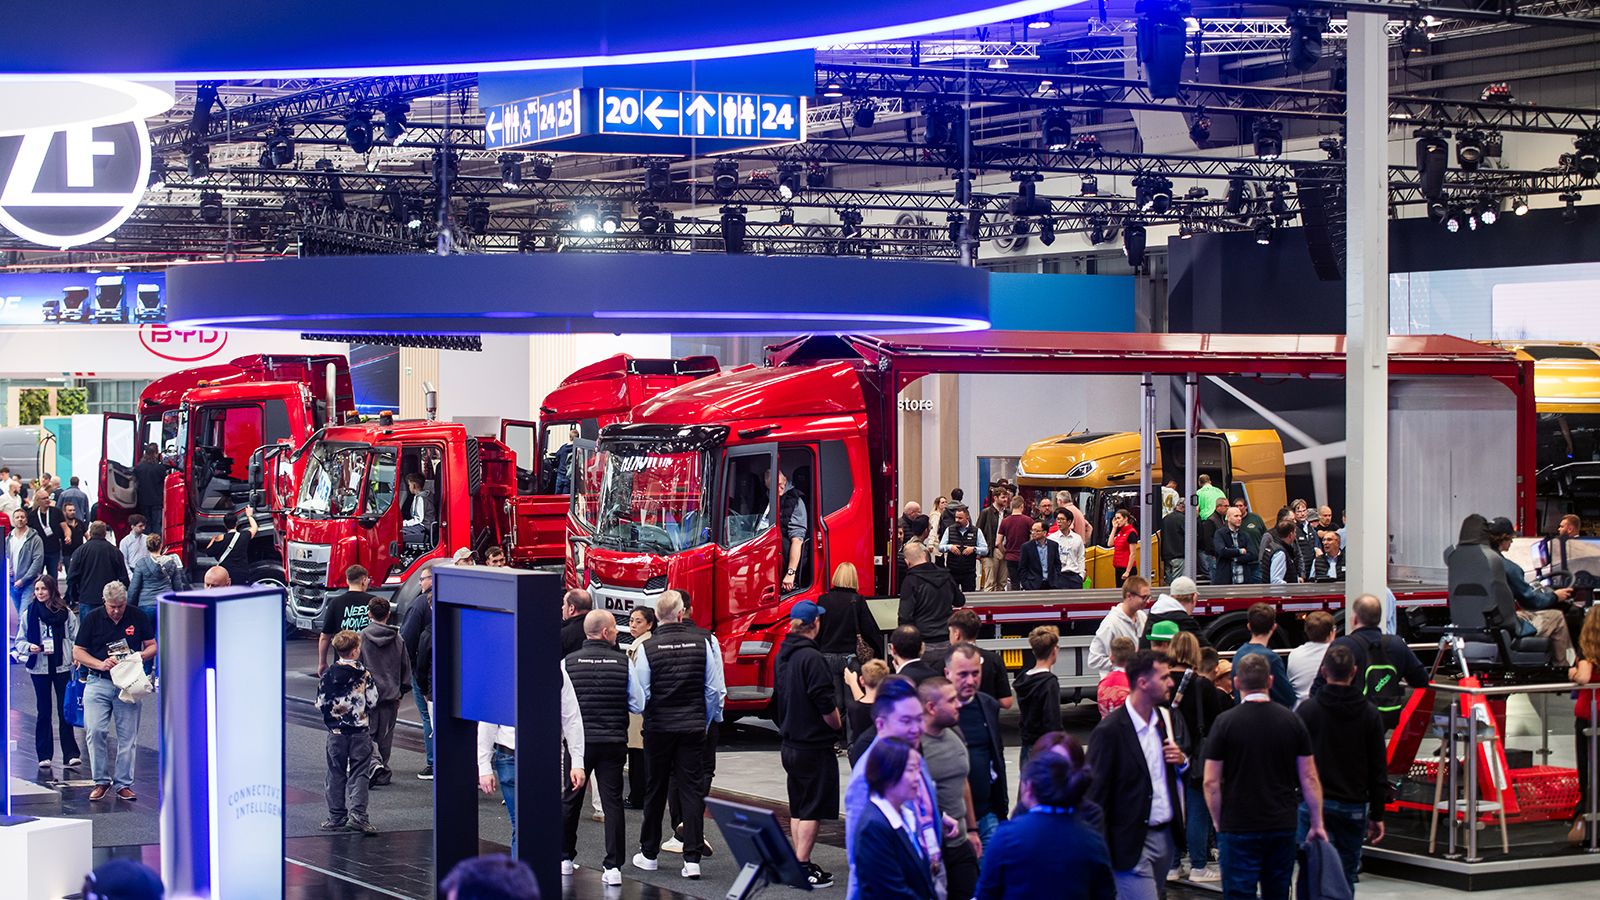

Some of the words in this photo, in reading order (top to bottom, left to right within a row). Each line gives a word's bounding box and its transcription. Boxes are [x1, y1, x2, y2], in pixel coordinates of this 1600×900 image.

[540, 102, 556, 131] 24
[557, 99, 573, 128] 25
[605, 96, 639, 125] 20
[761, 103, 795, 131] 24
[151, 324, 219, 343] BYD
[897, 397, 933, 411] store
[605, 596, 634, 613] DAF
